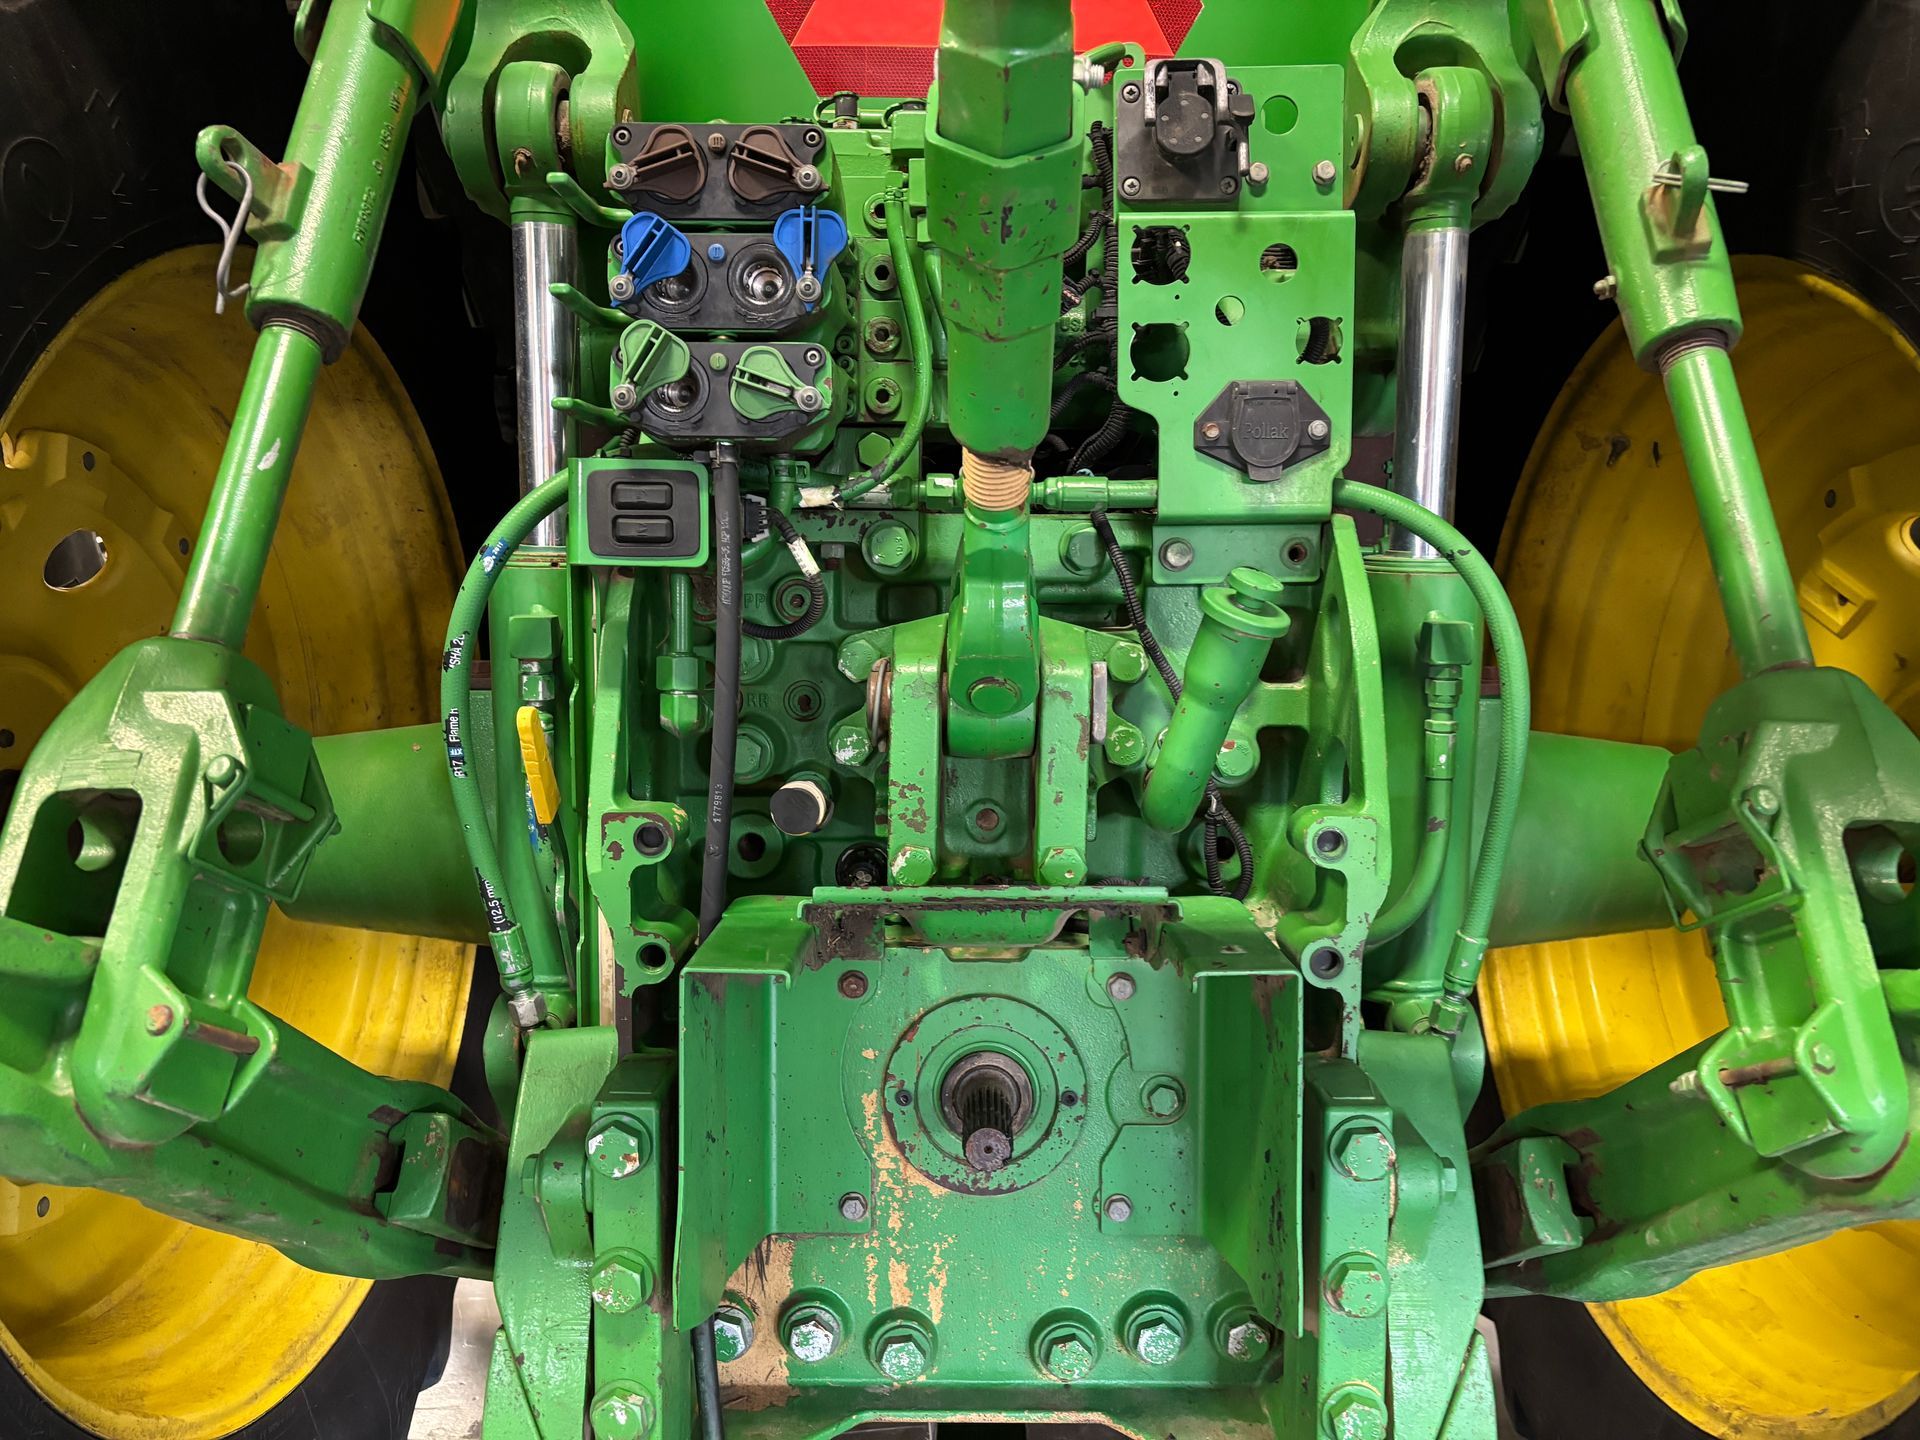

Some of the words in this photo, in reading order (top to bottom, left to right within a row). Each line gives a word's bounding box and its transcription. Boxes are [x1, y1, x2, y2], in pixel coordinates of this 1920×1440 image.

[1241, 421, 1288, 439] Pollak
[448, 716, 459, 742] Flame
[452, 759, 464, 778] R17
[712, 783, 723, 823] 1779813
[487, 898, 506, 924] (12.5
